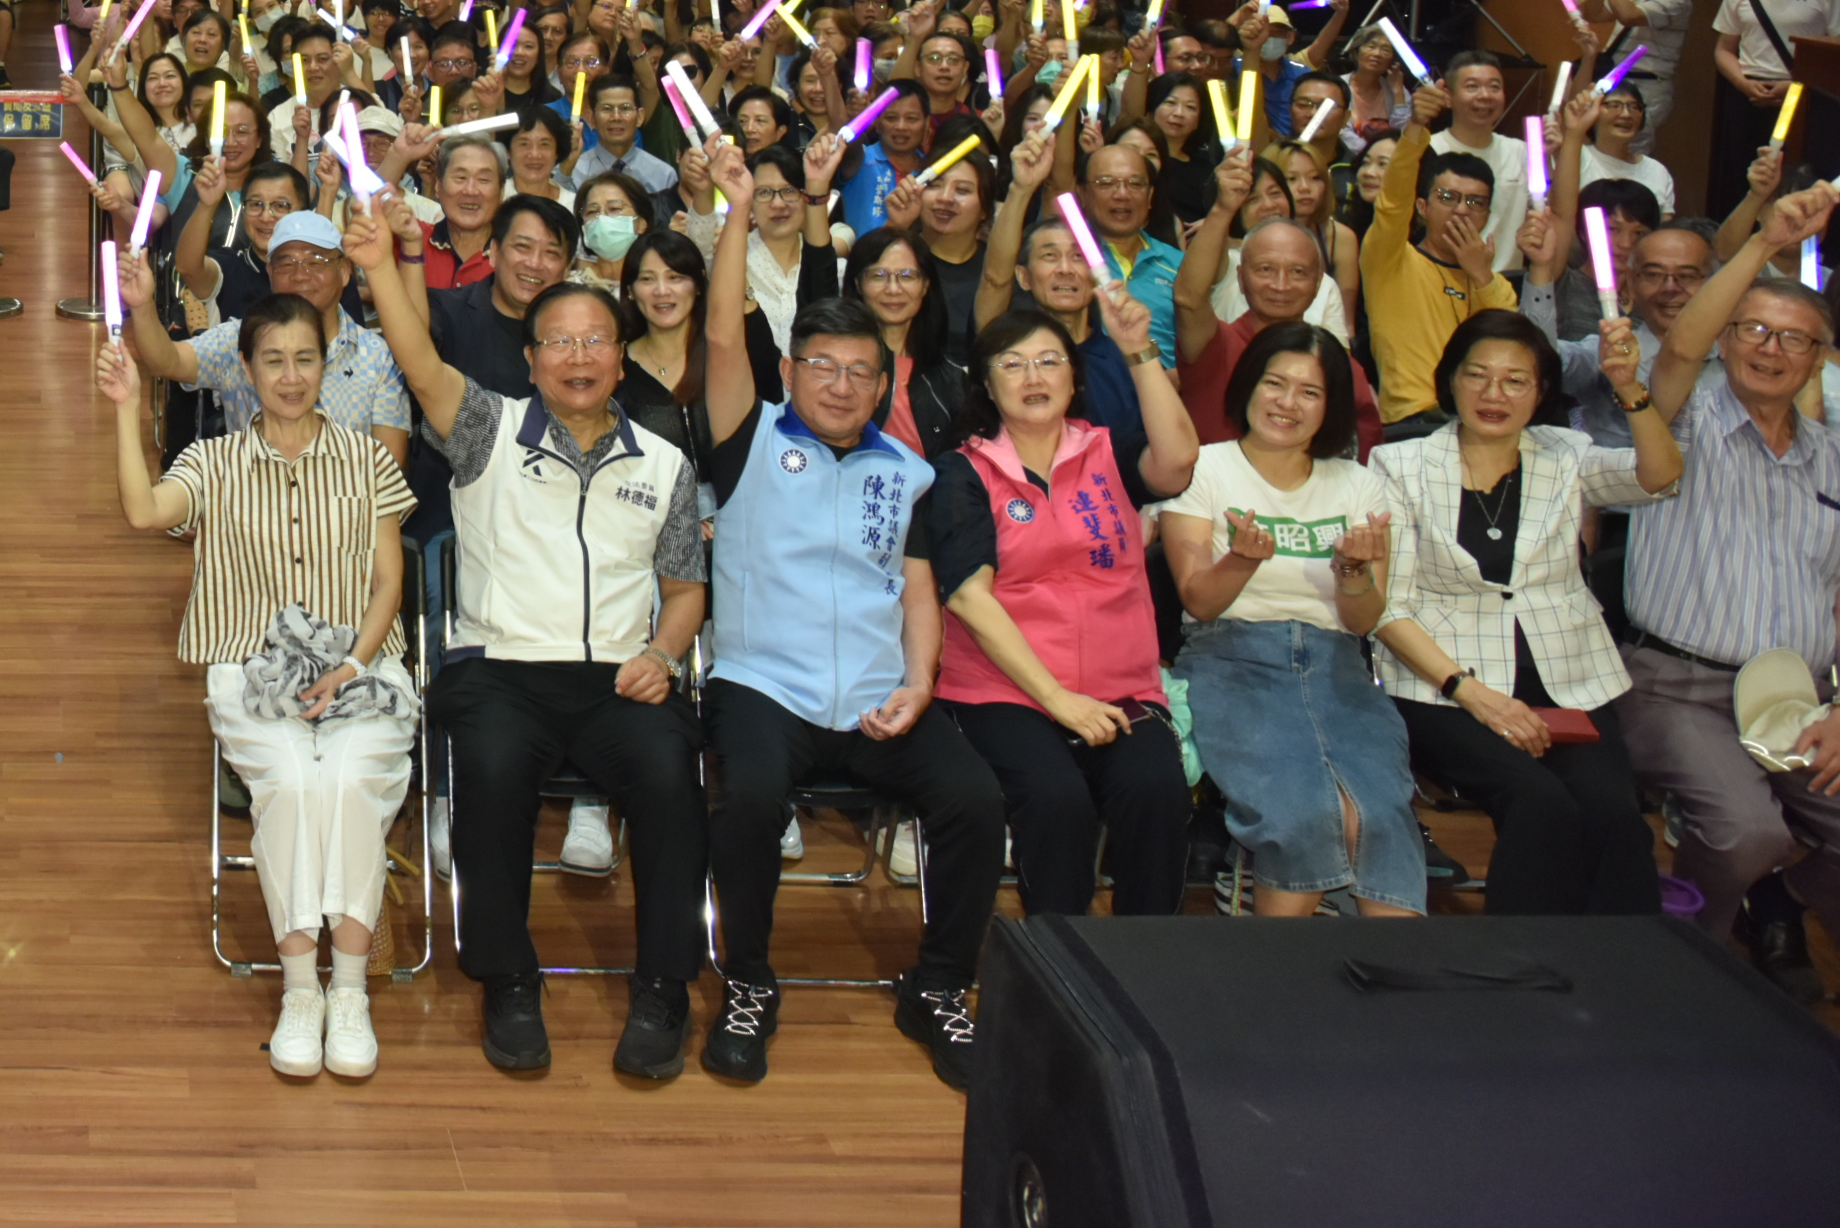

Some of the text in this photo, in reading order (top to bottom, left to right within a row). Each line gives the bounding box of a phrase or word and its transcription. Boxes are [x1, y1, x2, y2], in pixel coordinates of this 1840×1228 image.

[614, 485, 659, 512] 林德福
[861, 474, 887, 551] 陳鴻源
[878, 471, 907, 596] 新北市議會副長
